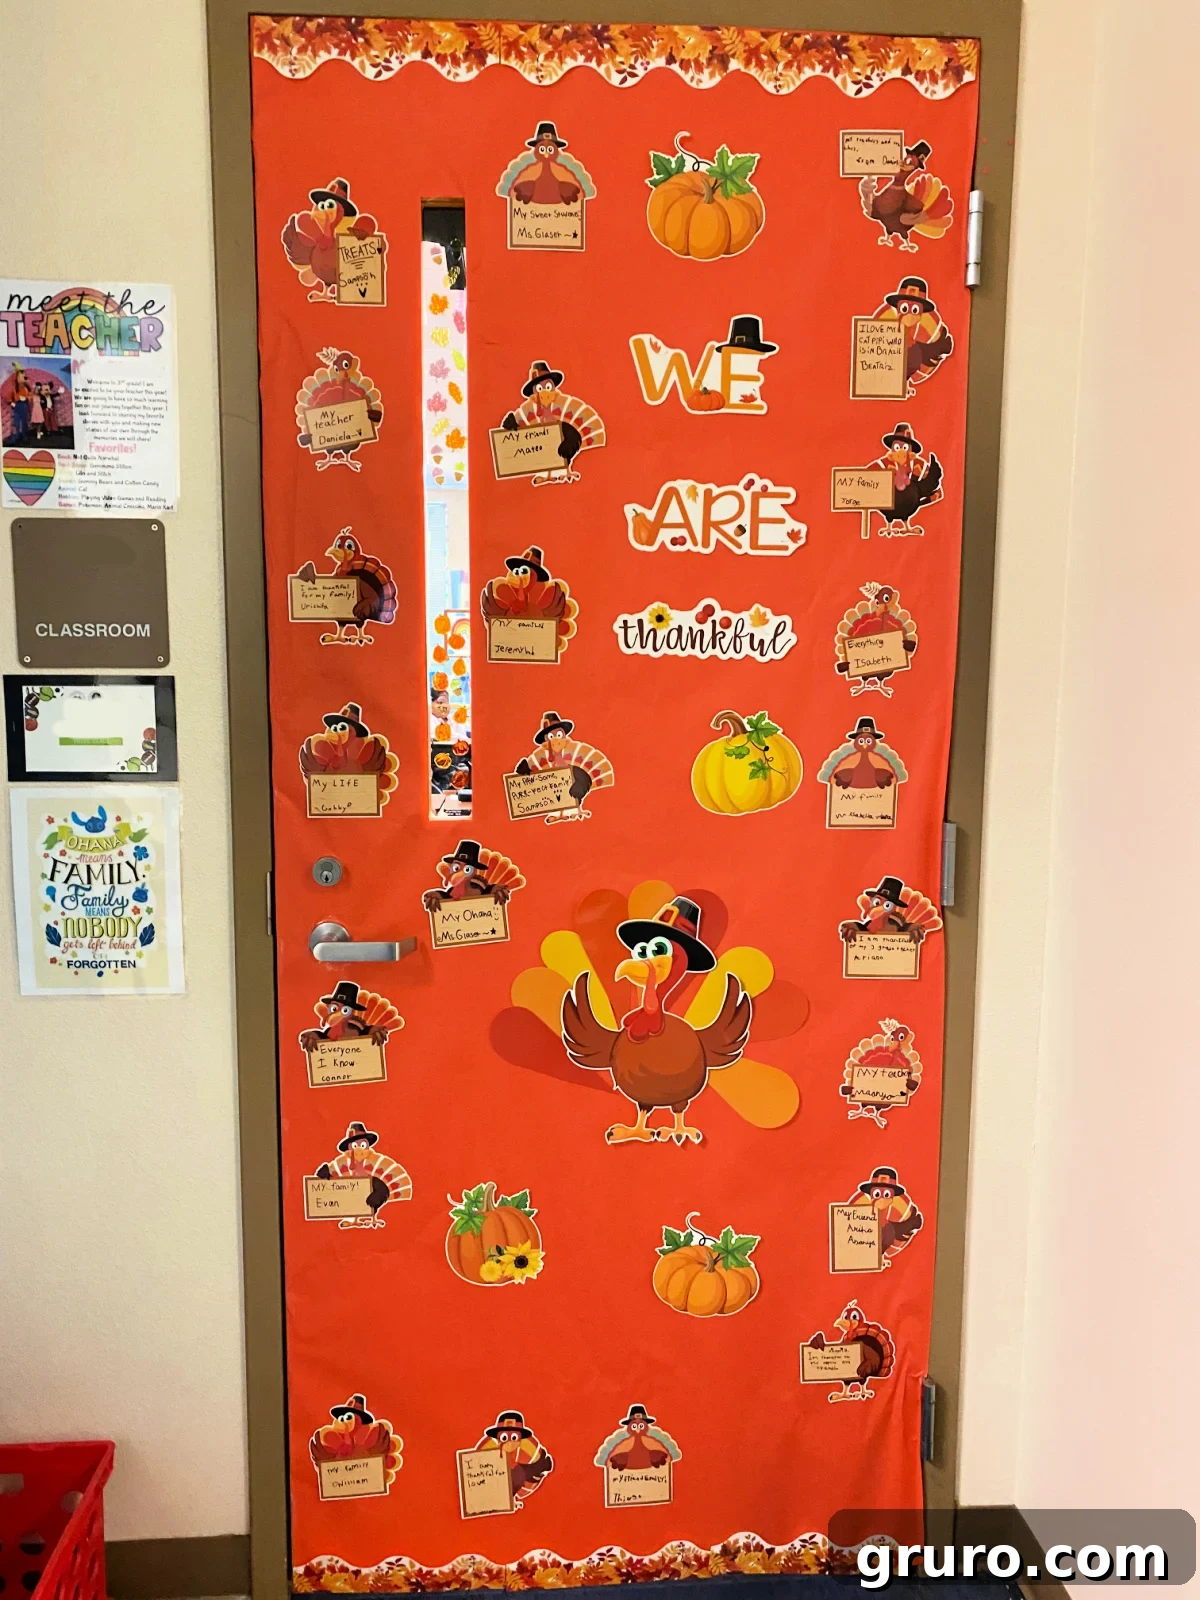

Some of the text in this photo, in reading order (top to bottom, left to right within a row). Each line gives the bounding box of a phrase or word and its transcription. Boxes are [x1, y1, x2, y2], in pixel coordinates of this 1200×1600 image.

[514, 208, 526, 220] My
[6, 288, 165, 316] meet the
[0, 311, 164, 353] TEACHER
[860, 324, 865, 333] I
[866, 324, 884, 333] LOVE
[631, 336, 765, 411] WE
[320, 410, 336, 420] My
[314, 414, 354, 430] teacher
[318, 432, 352, 445] Daniela
[89, 442, 136, 454] Favorites!
[514, 445, 542, 458] Mateo
[857, 476, 880, 489] family
[648, 486, 791, 551] ARE
[35, 623, 151, 637] CLASSROOM
[618, 617, 791, 656] thankful
[848, 638, 884, 649] Everything
[312, 778, 327, 792] My
[68, 835, 125, 852] OHANA
[76, 854, 113, 863] means
[61, 884, 129, 918] Family
[86, 907, 110, 916] MEANS
[442, 909, 492, 924] My Ohana
[62, 938, 137, 954] gets left behind
[66, 960, 137, 969] FORGOTTEN
[320, 1044, 361, 1057] Everyone
[317, 1058, 327, 1069] I
[331, 1181, 359, 1191] family!
[316, 1198, 340, 1208] Evan
[465, 1459, 473, 1469] I
[468, 1479, 486, 1488] love
